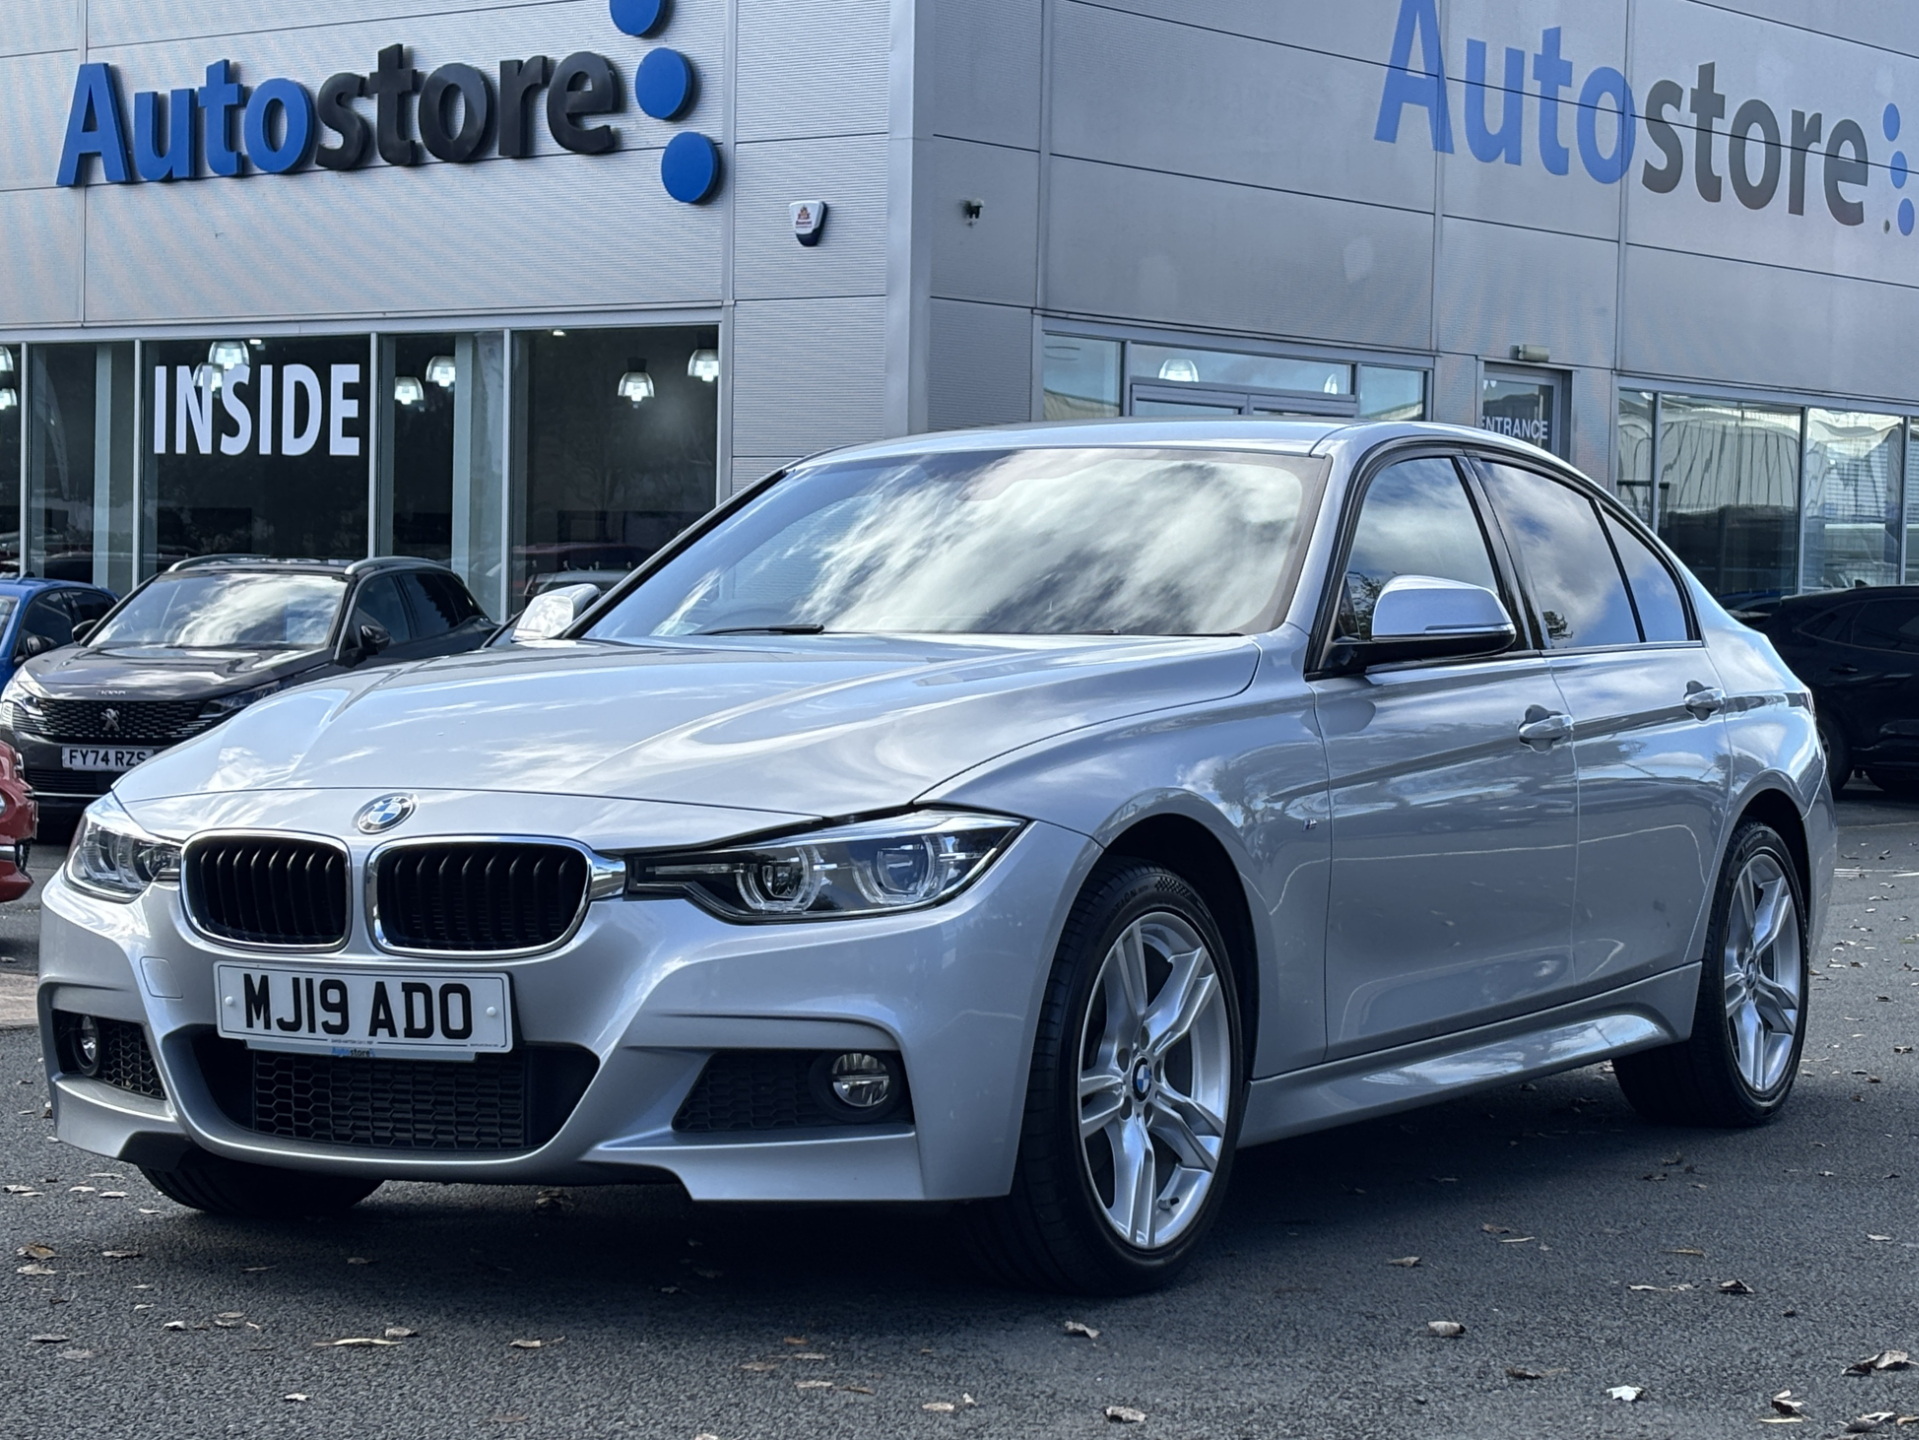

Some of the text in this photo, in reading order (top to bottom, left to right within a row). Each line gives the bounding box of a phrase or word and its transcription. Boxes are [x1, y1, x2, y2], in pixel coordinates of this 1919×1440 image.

[56, 43, 620, 188] Autostore
[1374, 0, 1868, 226] Autostore
[154, 363, 361, 456] INSIDE
[69, 748, 110, 766] FY74
[243, 973, 473, 1040] MJ19 ADO
